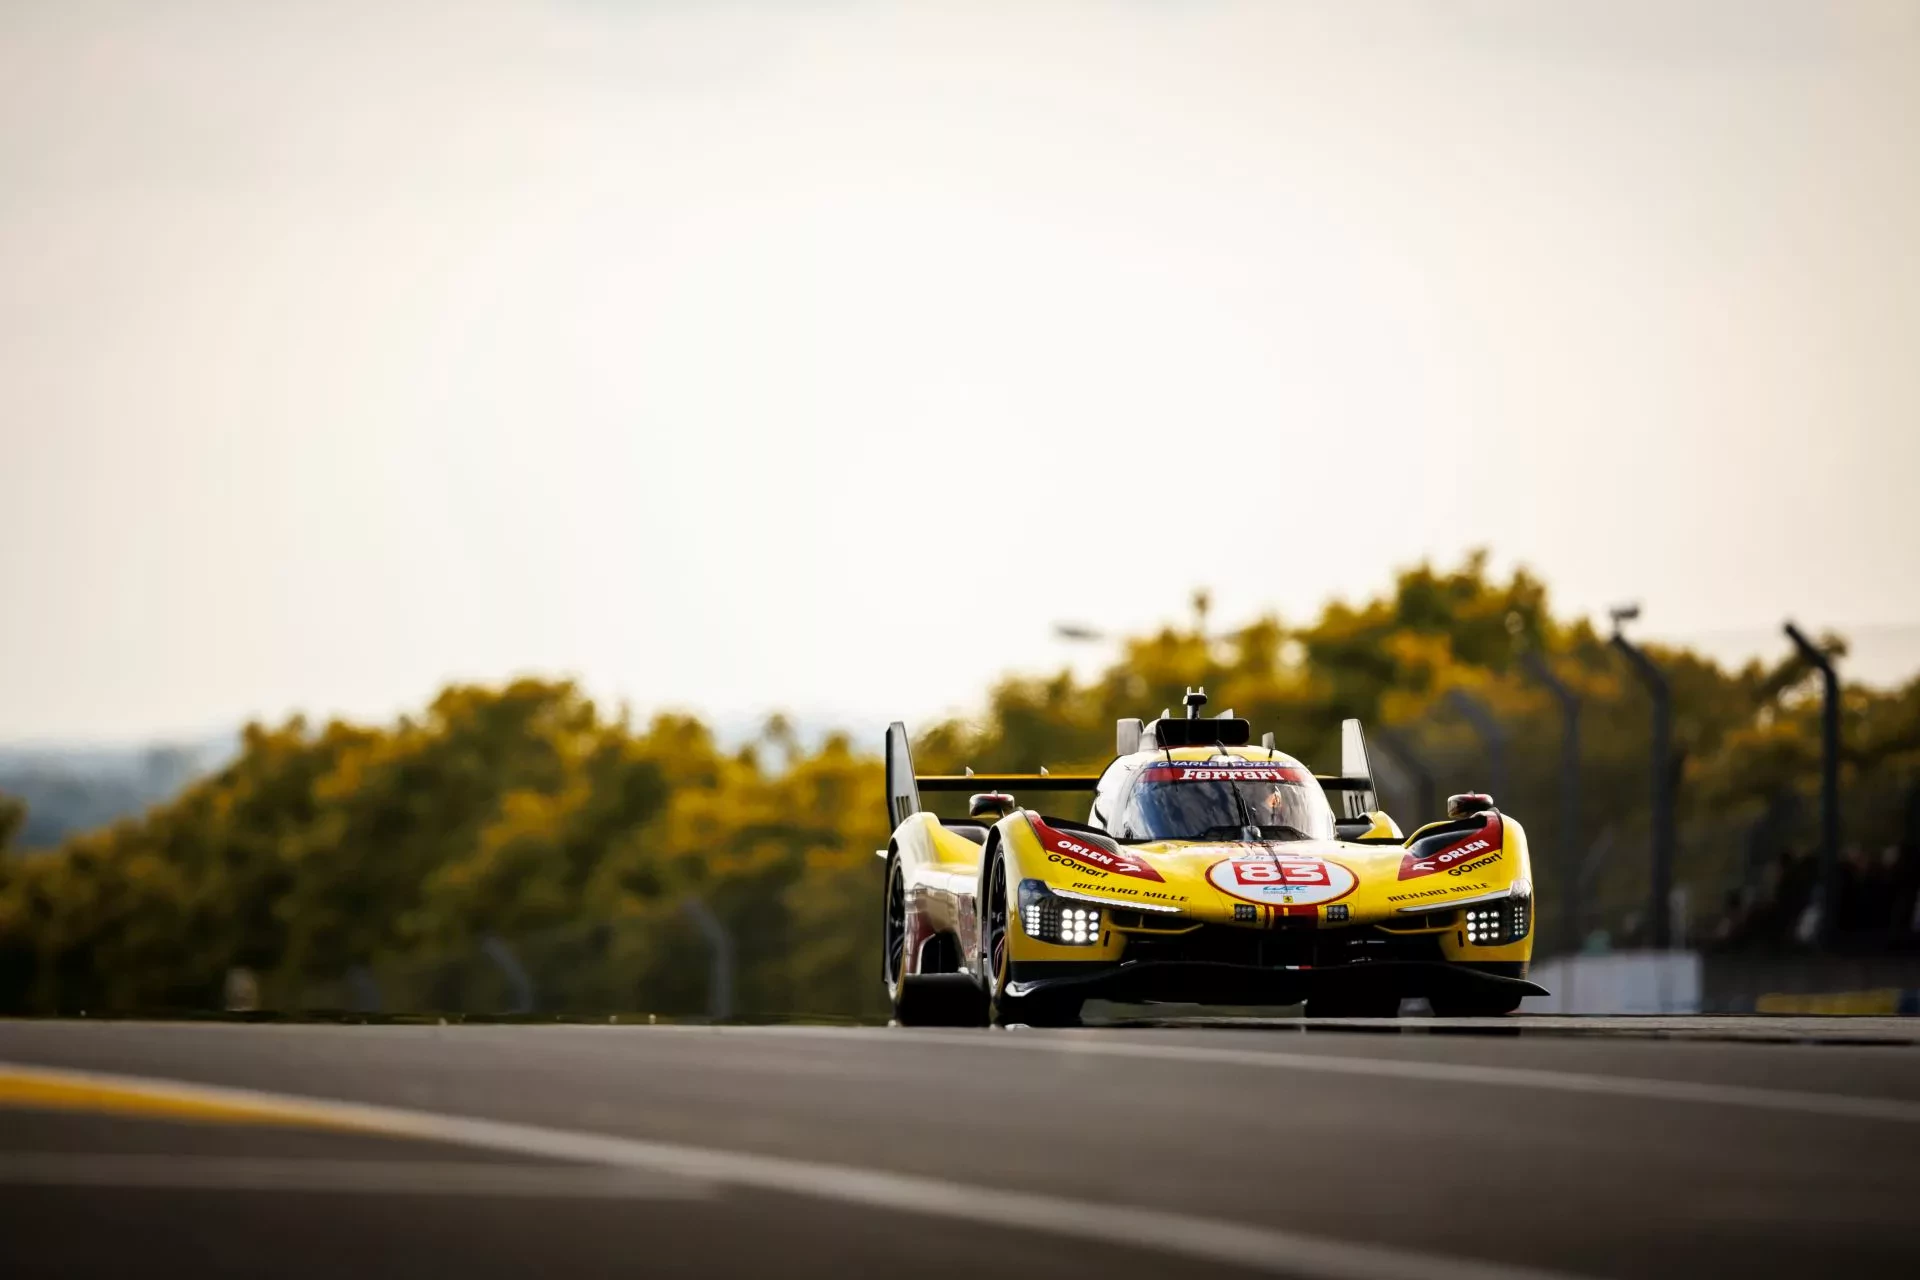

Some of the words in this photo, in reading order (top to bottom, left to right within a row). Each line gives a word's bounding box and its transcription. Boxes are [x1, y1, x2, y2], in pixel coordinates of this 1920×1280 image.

[1179, 768, 1285, 781] Ferrari
[1057, 840, 1114, 865] ORLEN
[1438, 839, 1490, 863] ORLEN
[1048, 853, 1109, 879] GOmart
[1239, 863, 1324, 882] 83
[1448, 852, 1503, 877] GOmart
[1071, 882, 1138, 895] RICHARD
[1143, 891, 1190, 902] MILLE
[1387, 888, 1448, 902] RICHARD
[1450, 882, 1492, 894] MILLE
